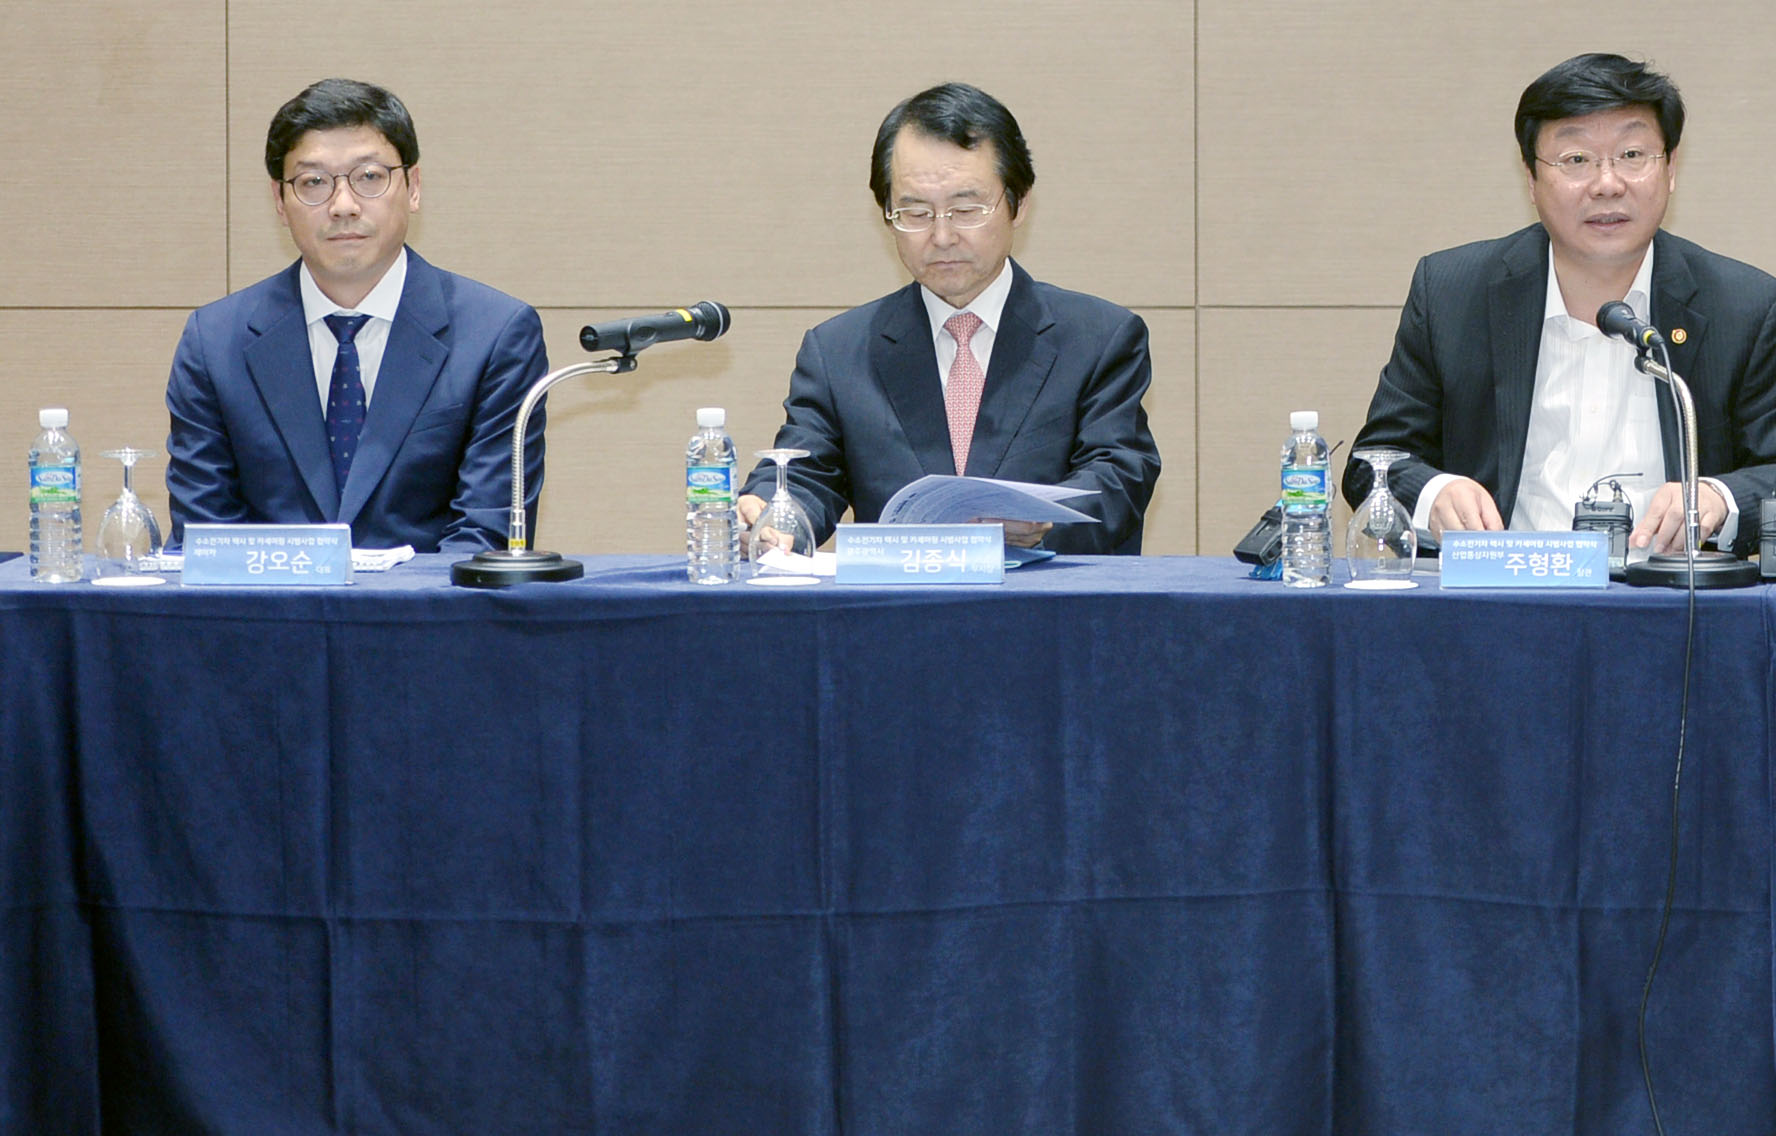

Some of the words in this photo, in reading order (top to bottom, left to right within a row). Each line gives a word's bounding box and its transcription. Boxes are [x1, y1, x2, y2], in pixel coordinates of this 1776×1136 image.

[246, 550, 312, 574] 강오순
[900, 549, 966, 573] 김종식
[1504, 553, 1573, 576] 주형환
